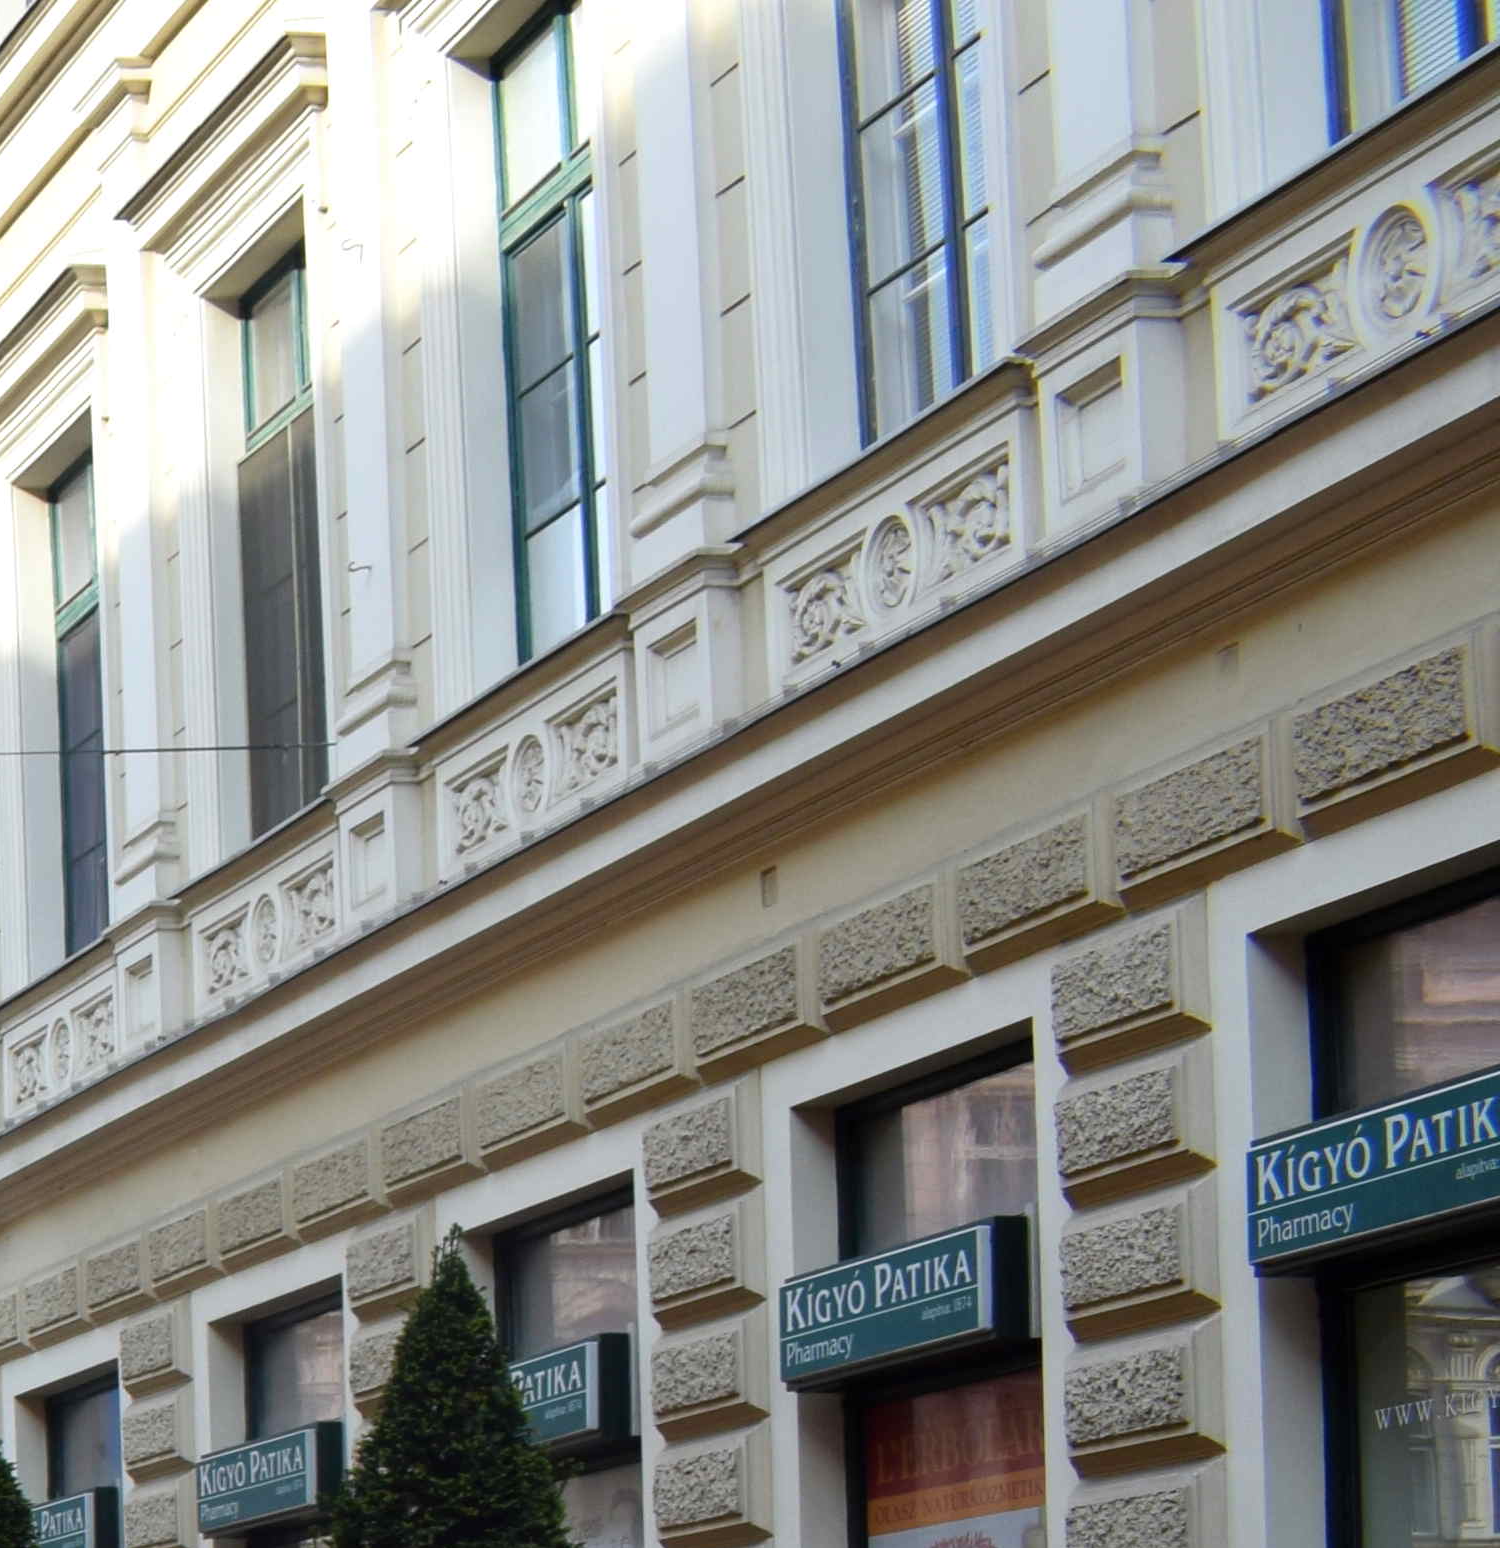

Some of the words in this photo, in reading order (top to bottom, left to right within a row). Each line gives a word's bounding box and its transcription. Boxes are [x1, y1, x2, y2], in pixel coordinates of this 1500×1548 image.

[1256, 1124, 1371, 1206] KÍGYÓ
[1257, 1203, 1353, 1248] Pharmacy
[785, 1269, 865, 1333] KÍGYÓ
[874, 1250, 972, 1309] PATIKA
[786, 1333, 854, 1369] Pharmacy
[200, 1453, 246, 1497] KÍGYÓ
[250, 1445, 304, 1483] PATIKA
[41, 1507, 84, 1540] PATIKA
